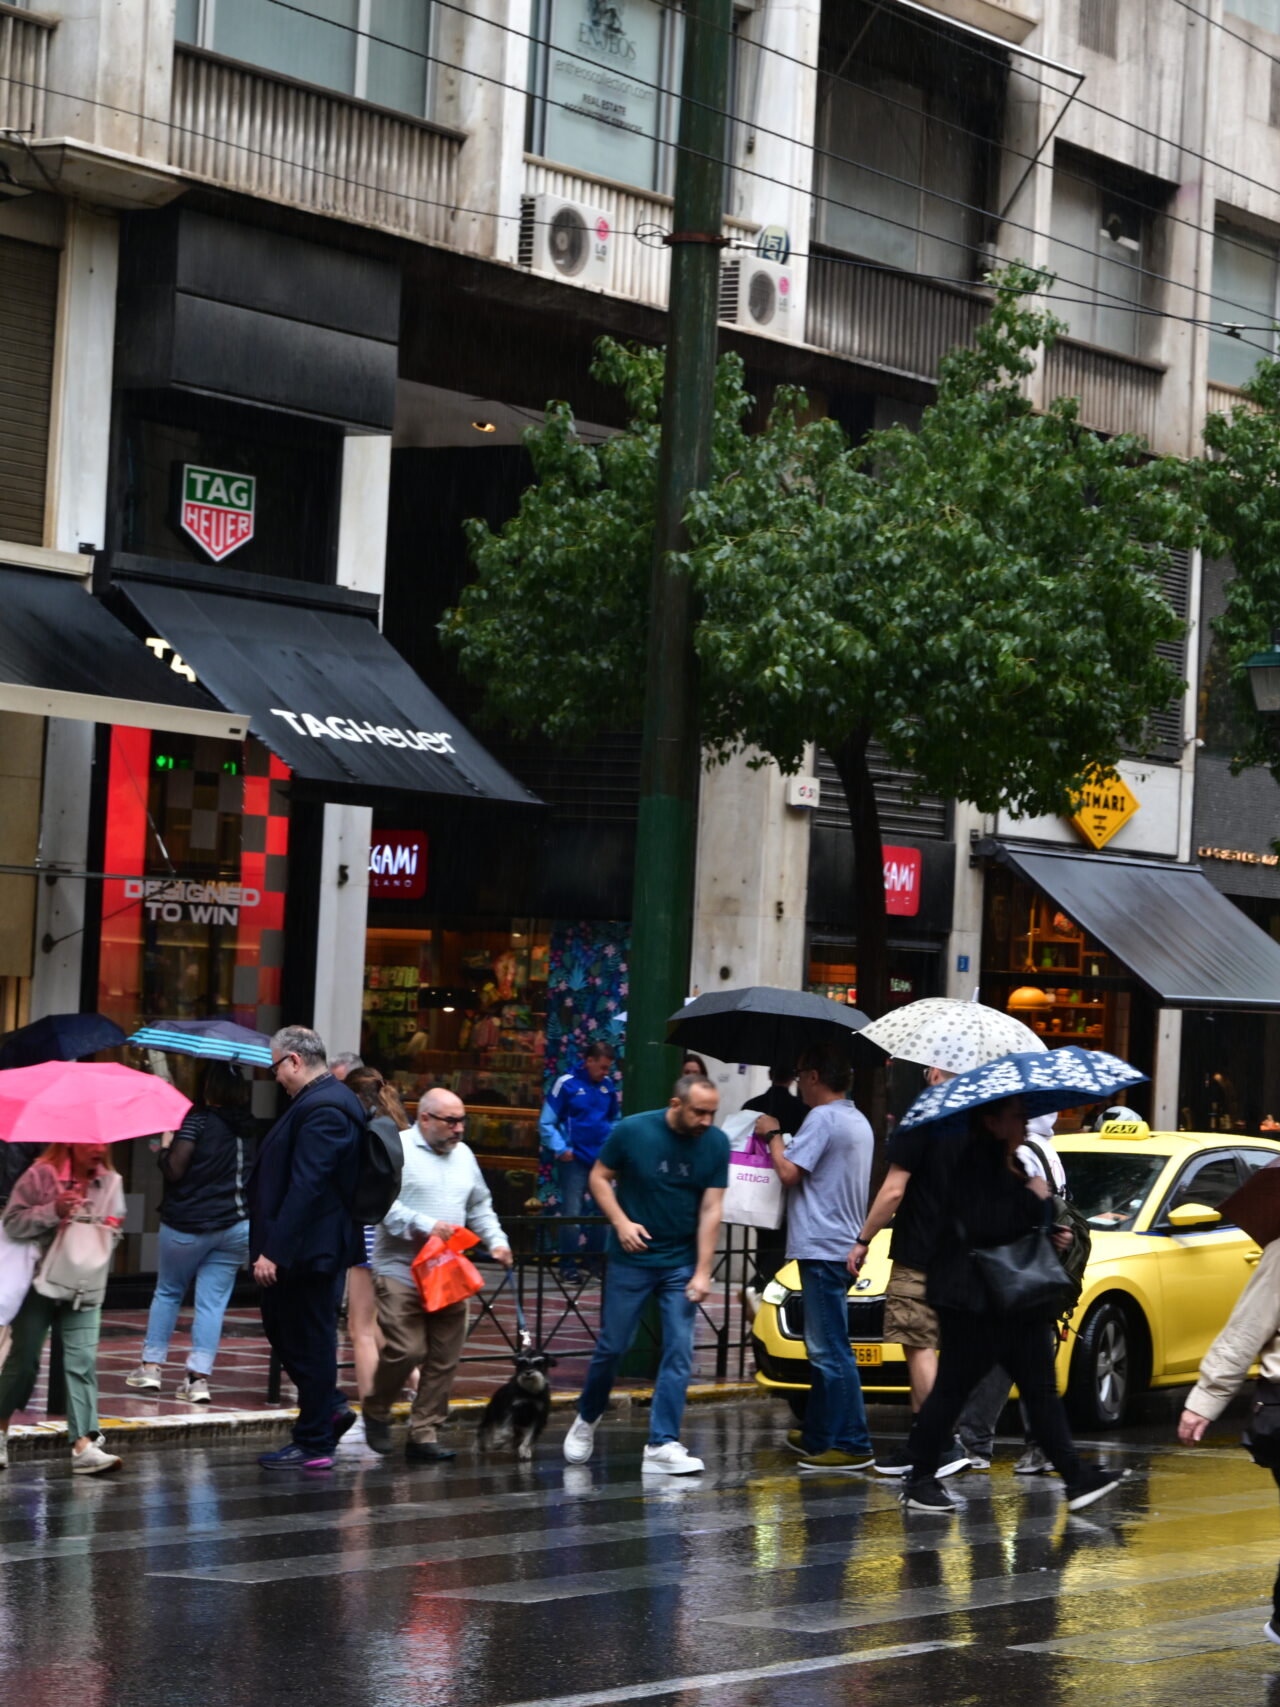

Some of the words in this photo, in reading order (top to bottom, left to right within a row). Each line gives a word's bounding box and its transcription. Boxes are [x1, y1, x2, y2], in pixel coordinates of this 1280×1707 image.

[189, 472, 249, 507] TAG
[186, 506, 249, 551] HEUER
[124, 879, 261, 907] DESIGNED
[145, 902, 182, 922] TO
[189, 905, 239, 926] WIN
[1105, 1124, 1139, 1134] TAXI
[737, 1170, 770, 1184] attica
